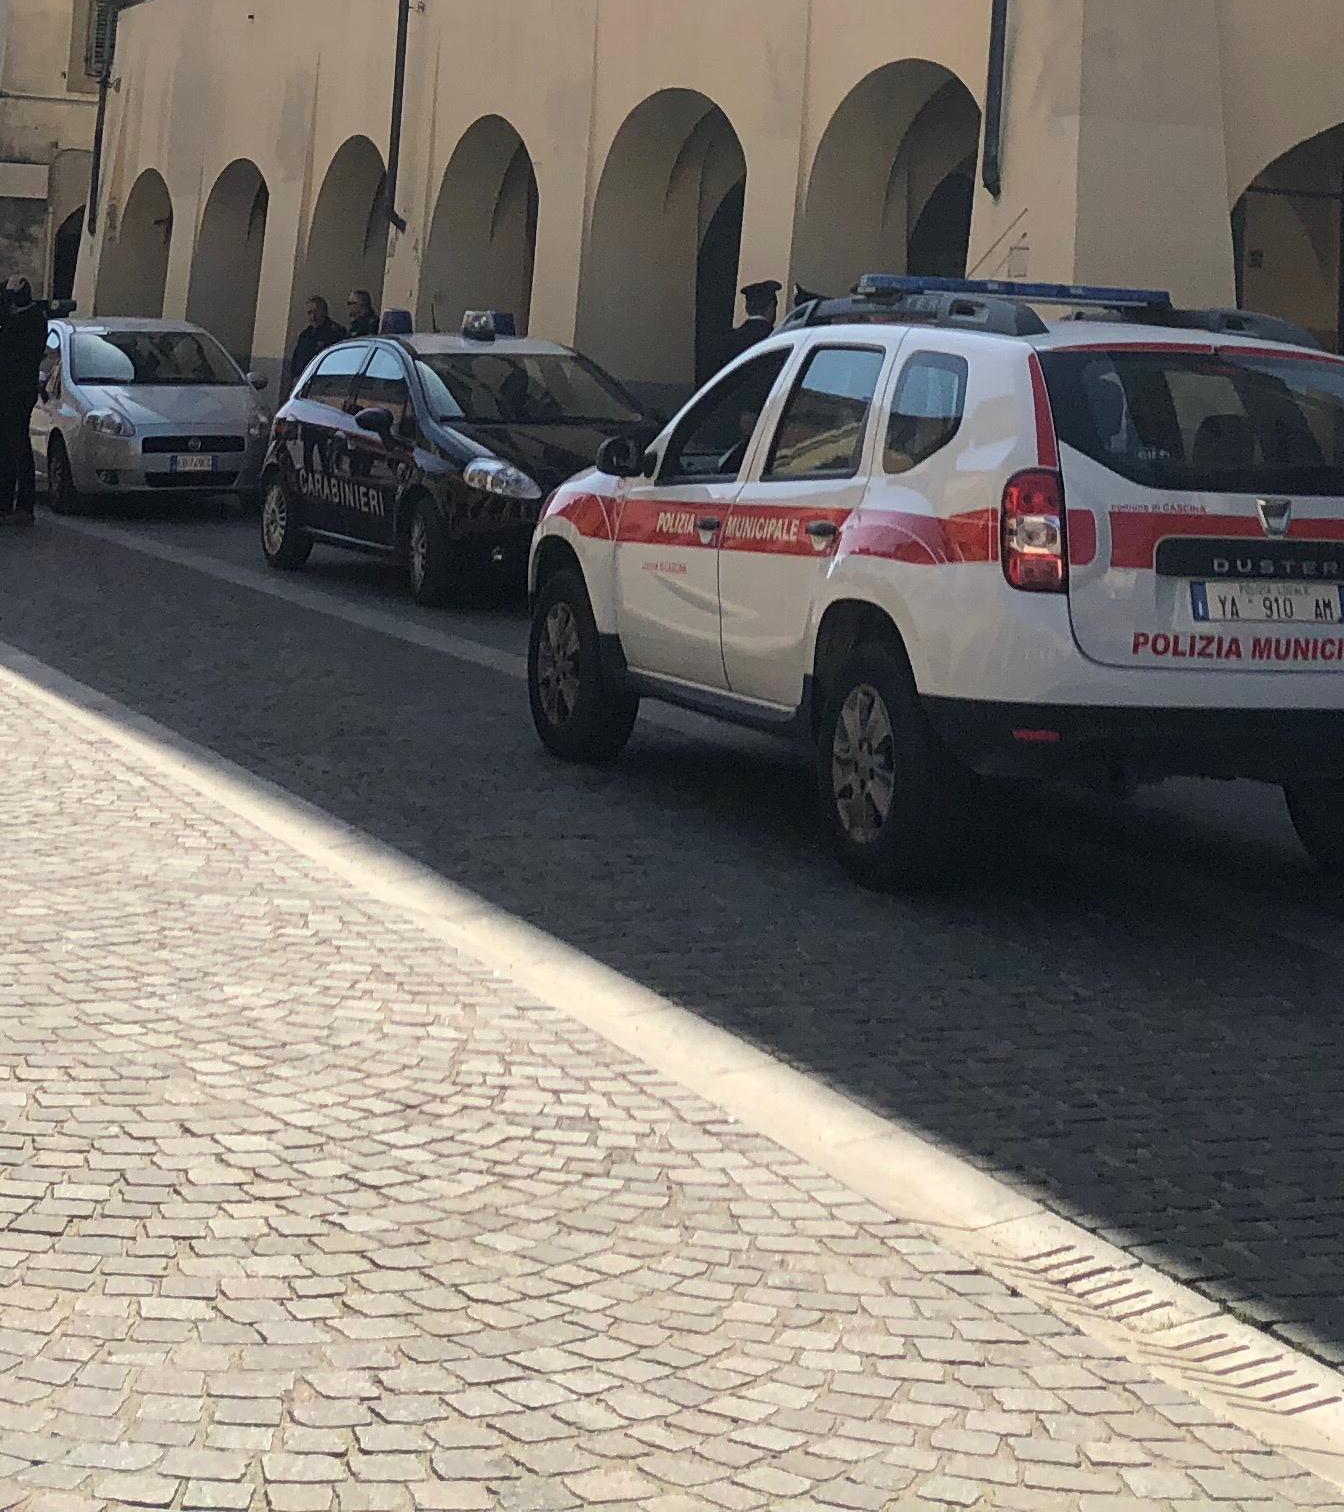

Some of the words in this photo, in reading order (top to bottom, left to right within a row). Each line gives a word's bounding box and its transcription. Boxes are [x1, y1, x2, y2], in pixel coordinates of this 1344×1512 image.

[299, 468, 384, 517] CARABINIERI
[657, 512, 695, 534] POLIZIA
[725, 515, 799, 541] MUNICIPALE
[1213, 558, 1338, 575] DUSTER
[1218, 595, 1240, 618] YA
[1262, 596, 1294, 618] 910
[1314, 597, 1334, 620] AM
[1132, 631, 1243, 660] POLIZIA
